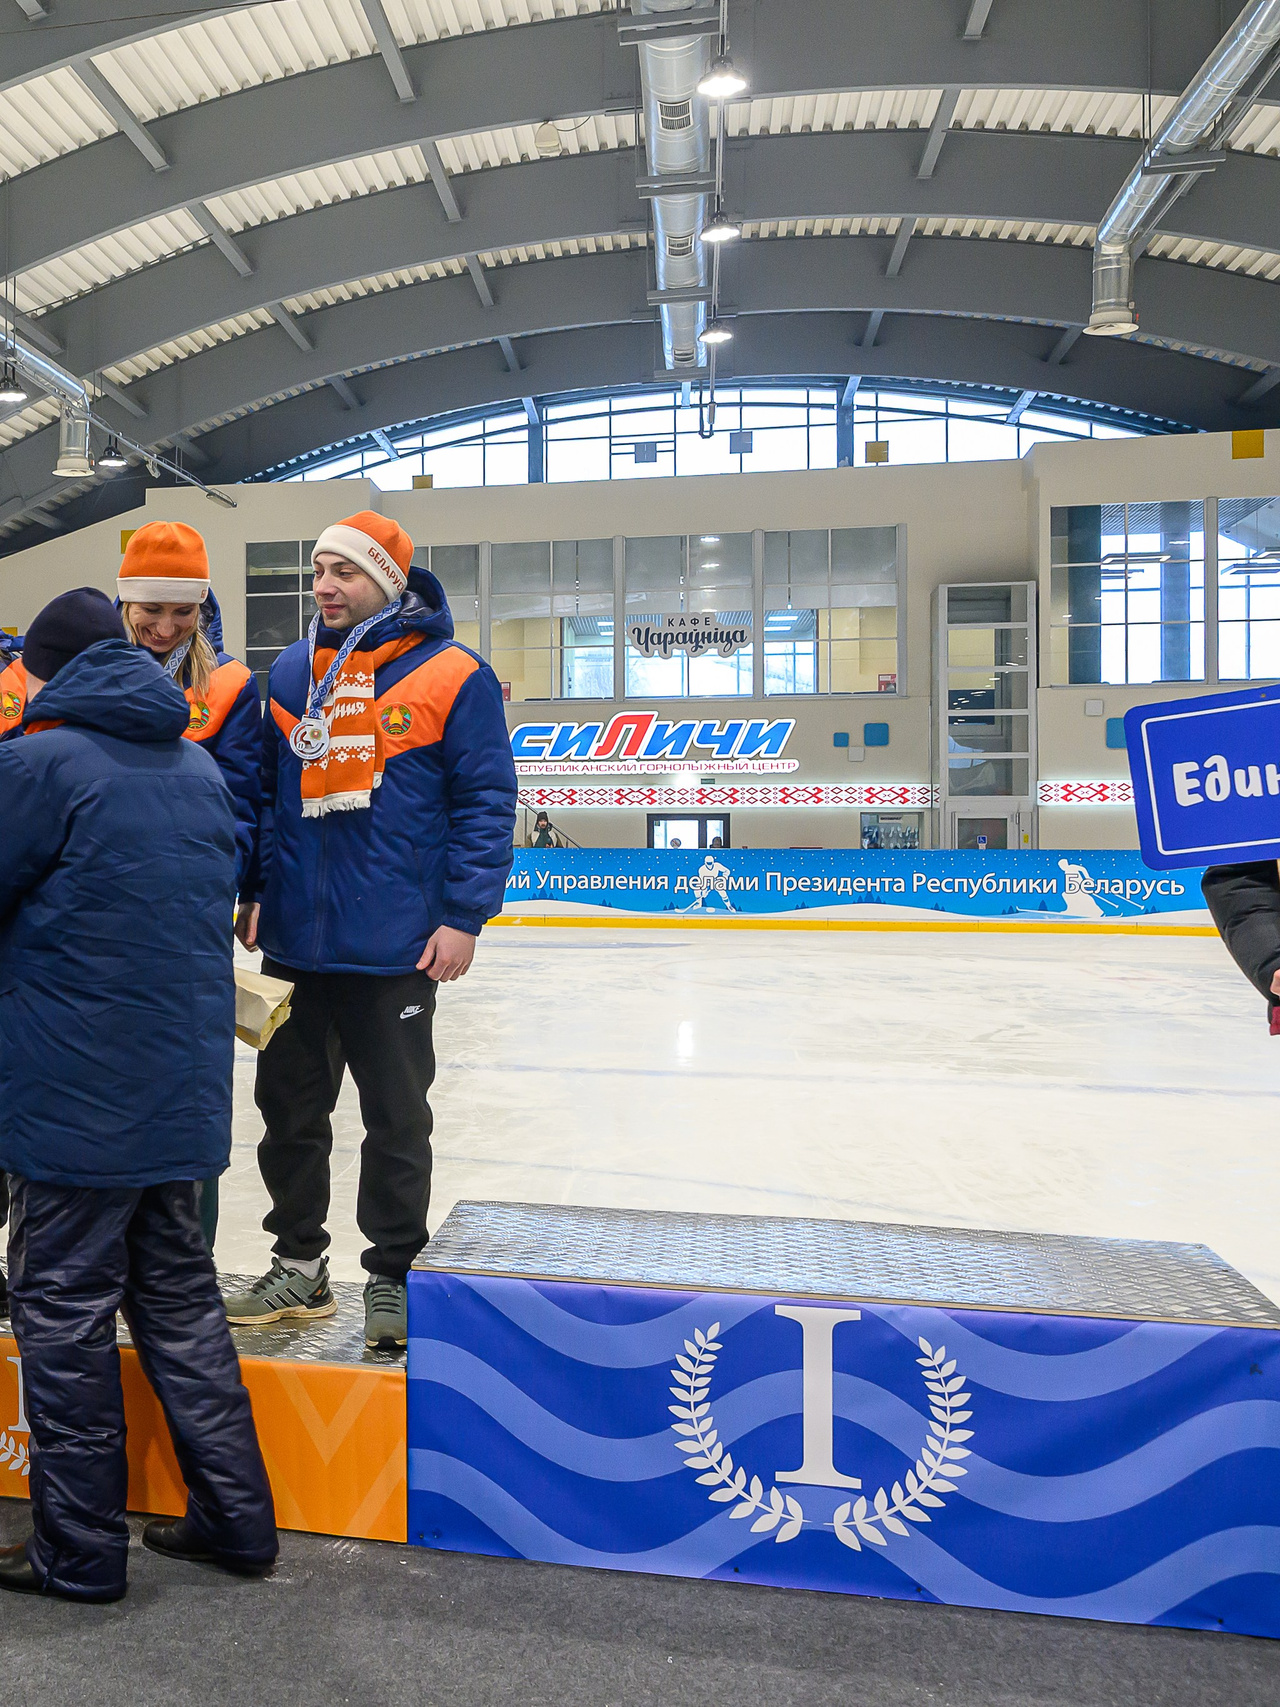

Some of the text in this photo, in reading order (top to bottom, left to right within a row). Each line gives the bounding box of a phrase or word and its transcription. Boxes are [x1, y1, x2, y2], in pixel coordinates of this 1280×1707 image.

[667, 616, 711, 628] КАФЕ
[631, 626, 748, 655] Чараўніца
[515, 760, 796, 774] ЕСПУБЛИКАНСКИЙ ГОРНОЛЫЖНЫЙ ЦЕНТР
[505, 870, 1186, 900] ий Управления делами Президента Республики Беларусь
